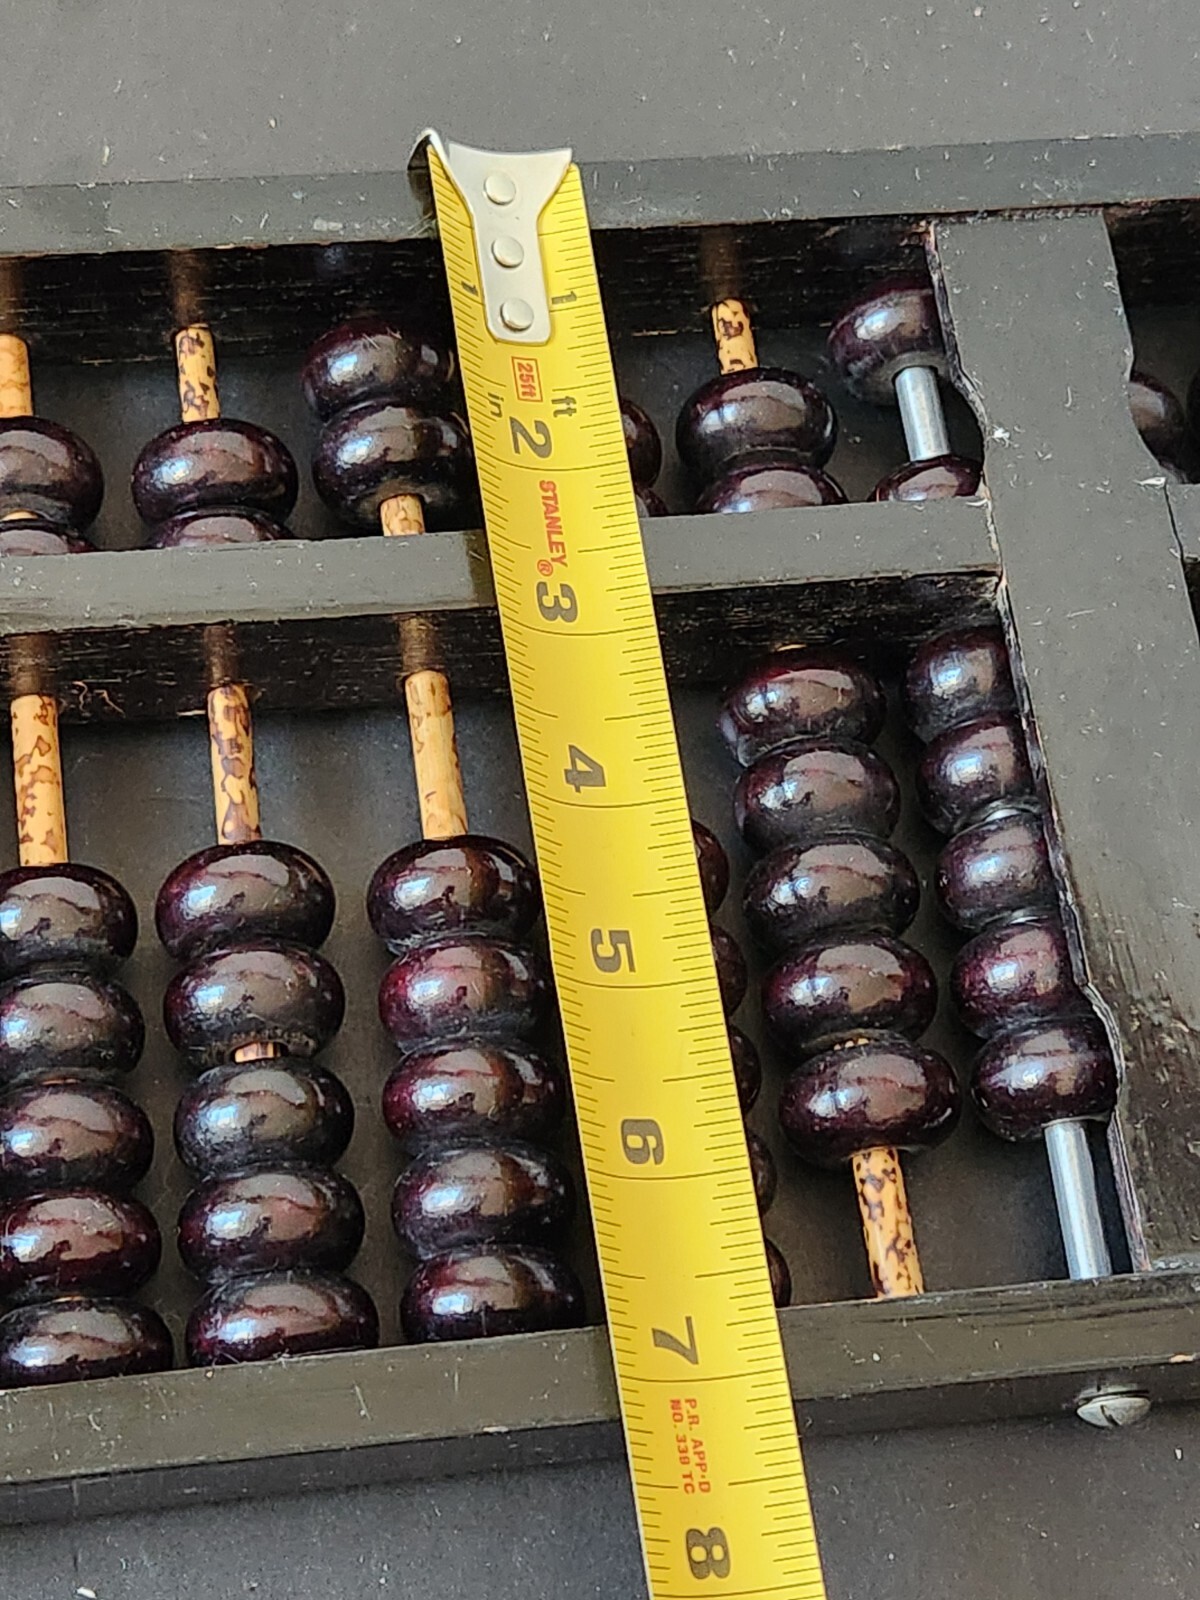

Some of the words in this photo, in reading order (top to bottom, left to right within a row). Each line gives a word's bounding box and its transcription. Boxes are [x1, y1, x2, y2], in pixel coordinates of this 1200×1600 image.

[551, 290, 577, 305] 1
[515, 361, 538, 400] 25ft
[487, 391, 505, 418] in
[551, 395, 577, 418] ft
[509, 416, 554, 459] 2
[536, 581, 579, 624] 3
[563, 744, 607, 794] 4
[590, 927, 637, 974] 5
[620, 1117, 665, 1166] 6
[651, 1315, 700, 1366] 7
[682, 1470, 696, 1495] TC
[685, 1526, 732, 1580] 8
